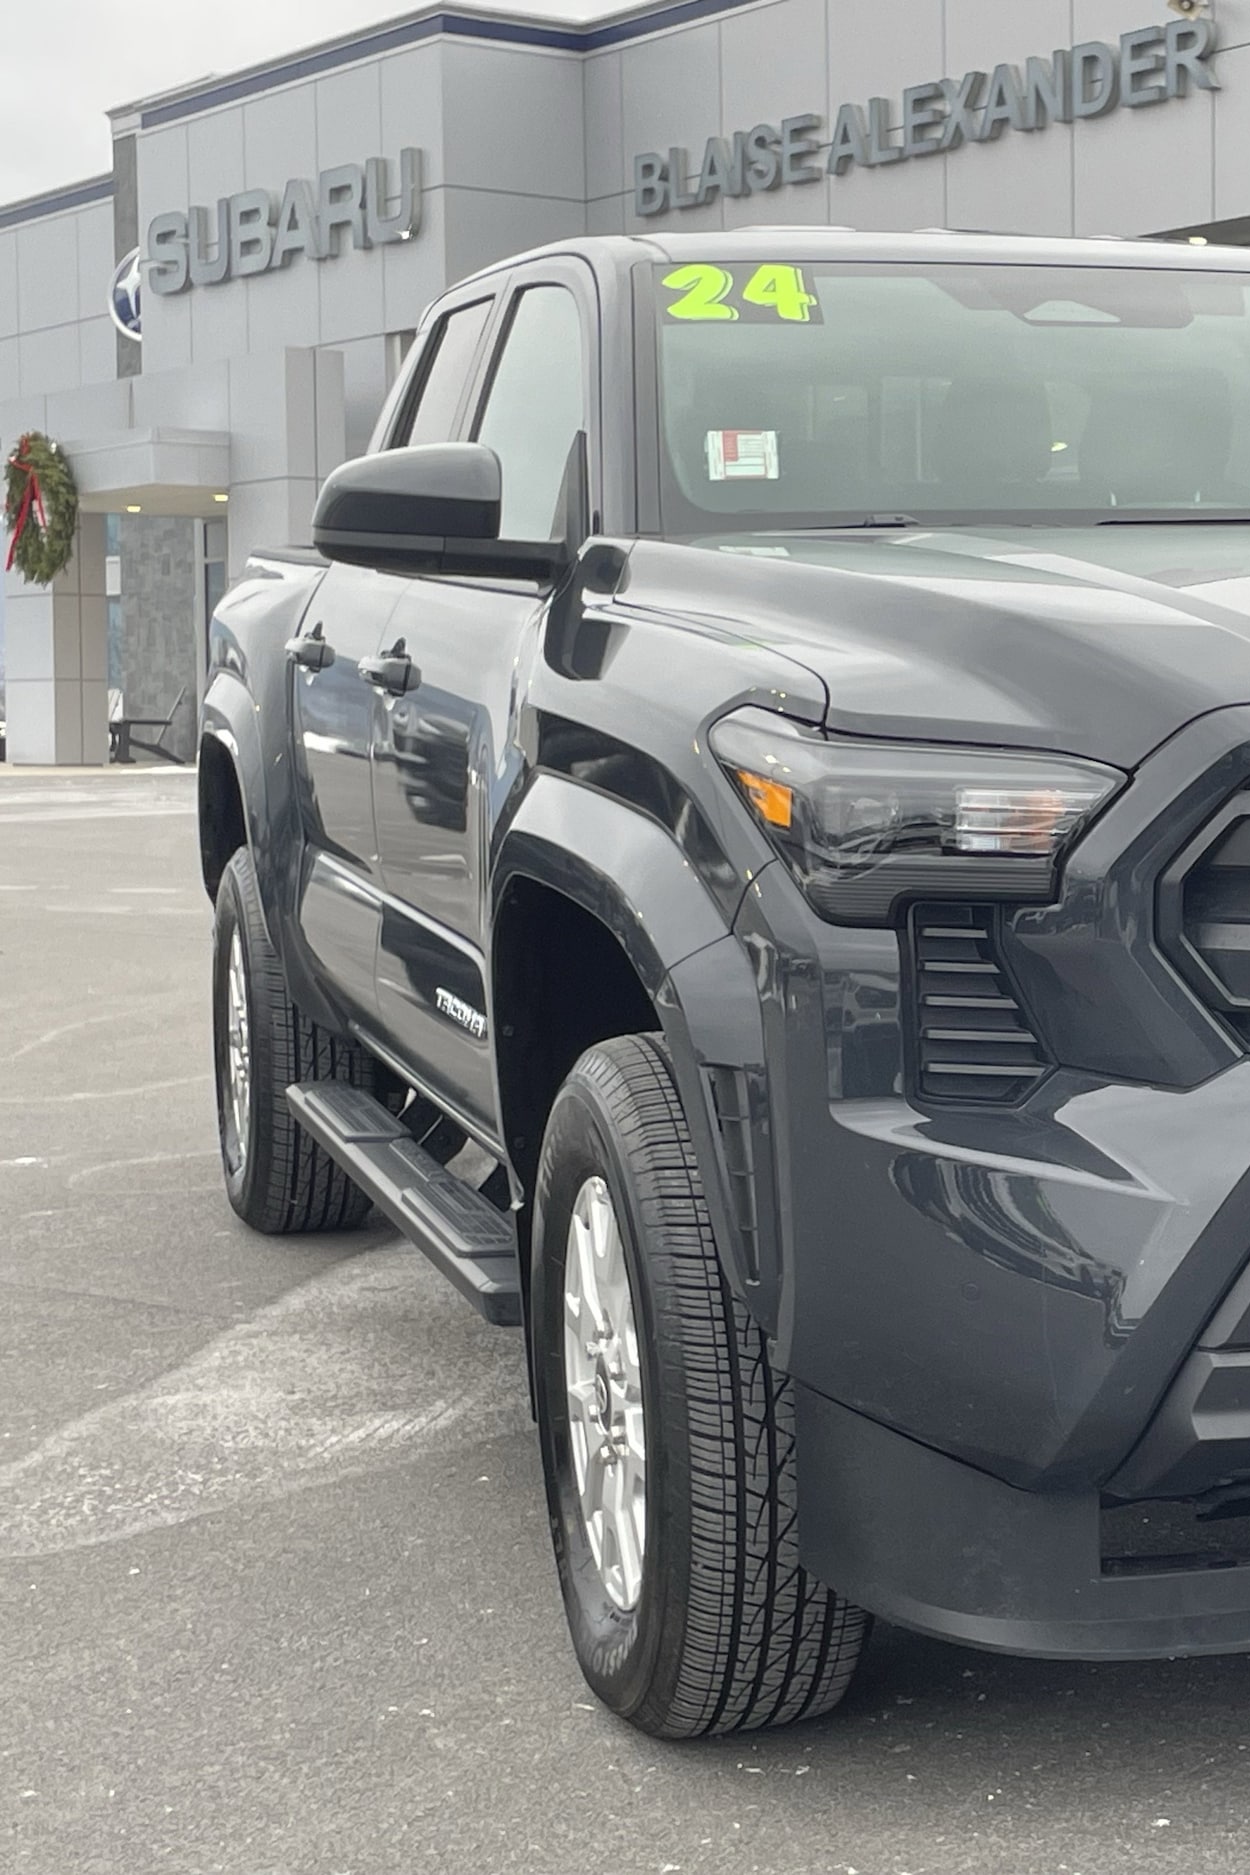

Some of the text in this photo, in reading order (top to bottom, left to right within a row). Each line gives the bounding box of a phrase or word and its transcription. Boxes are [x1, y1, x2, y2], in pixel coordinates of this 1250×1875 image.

[633, 19, 1222, 217] BLAISE ALEXANDER
[147, 146, 423, 296] SUBARU
[662, 263, 818, 321] 24
[435, 986, 487, 1039] TACOMA
